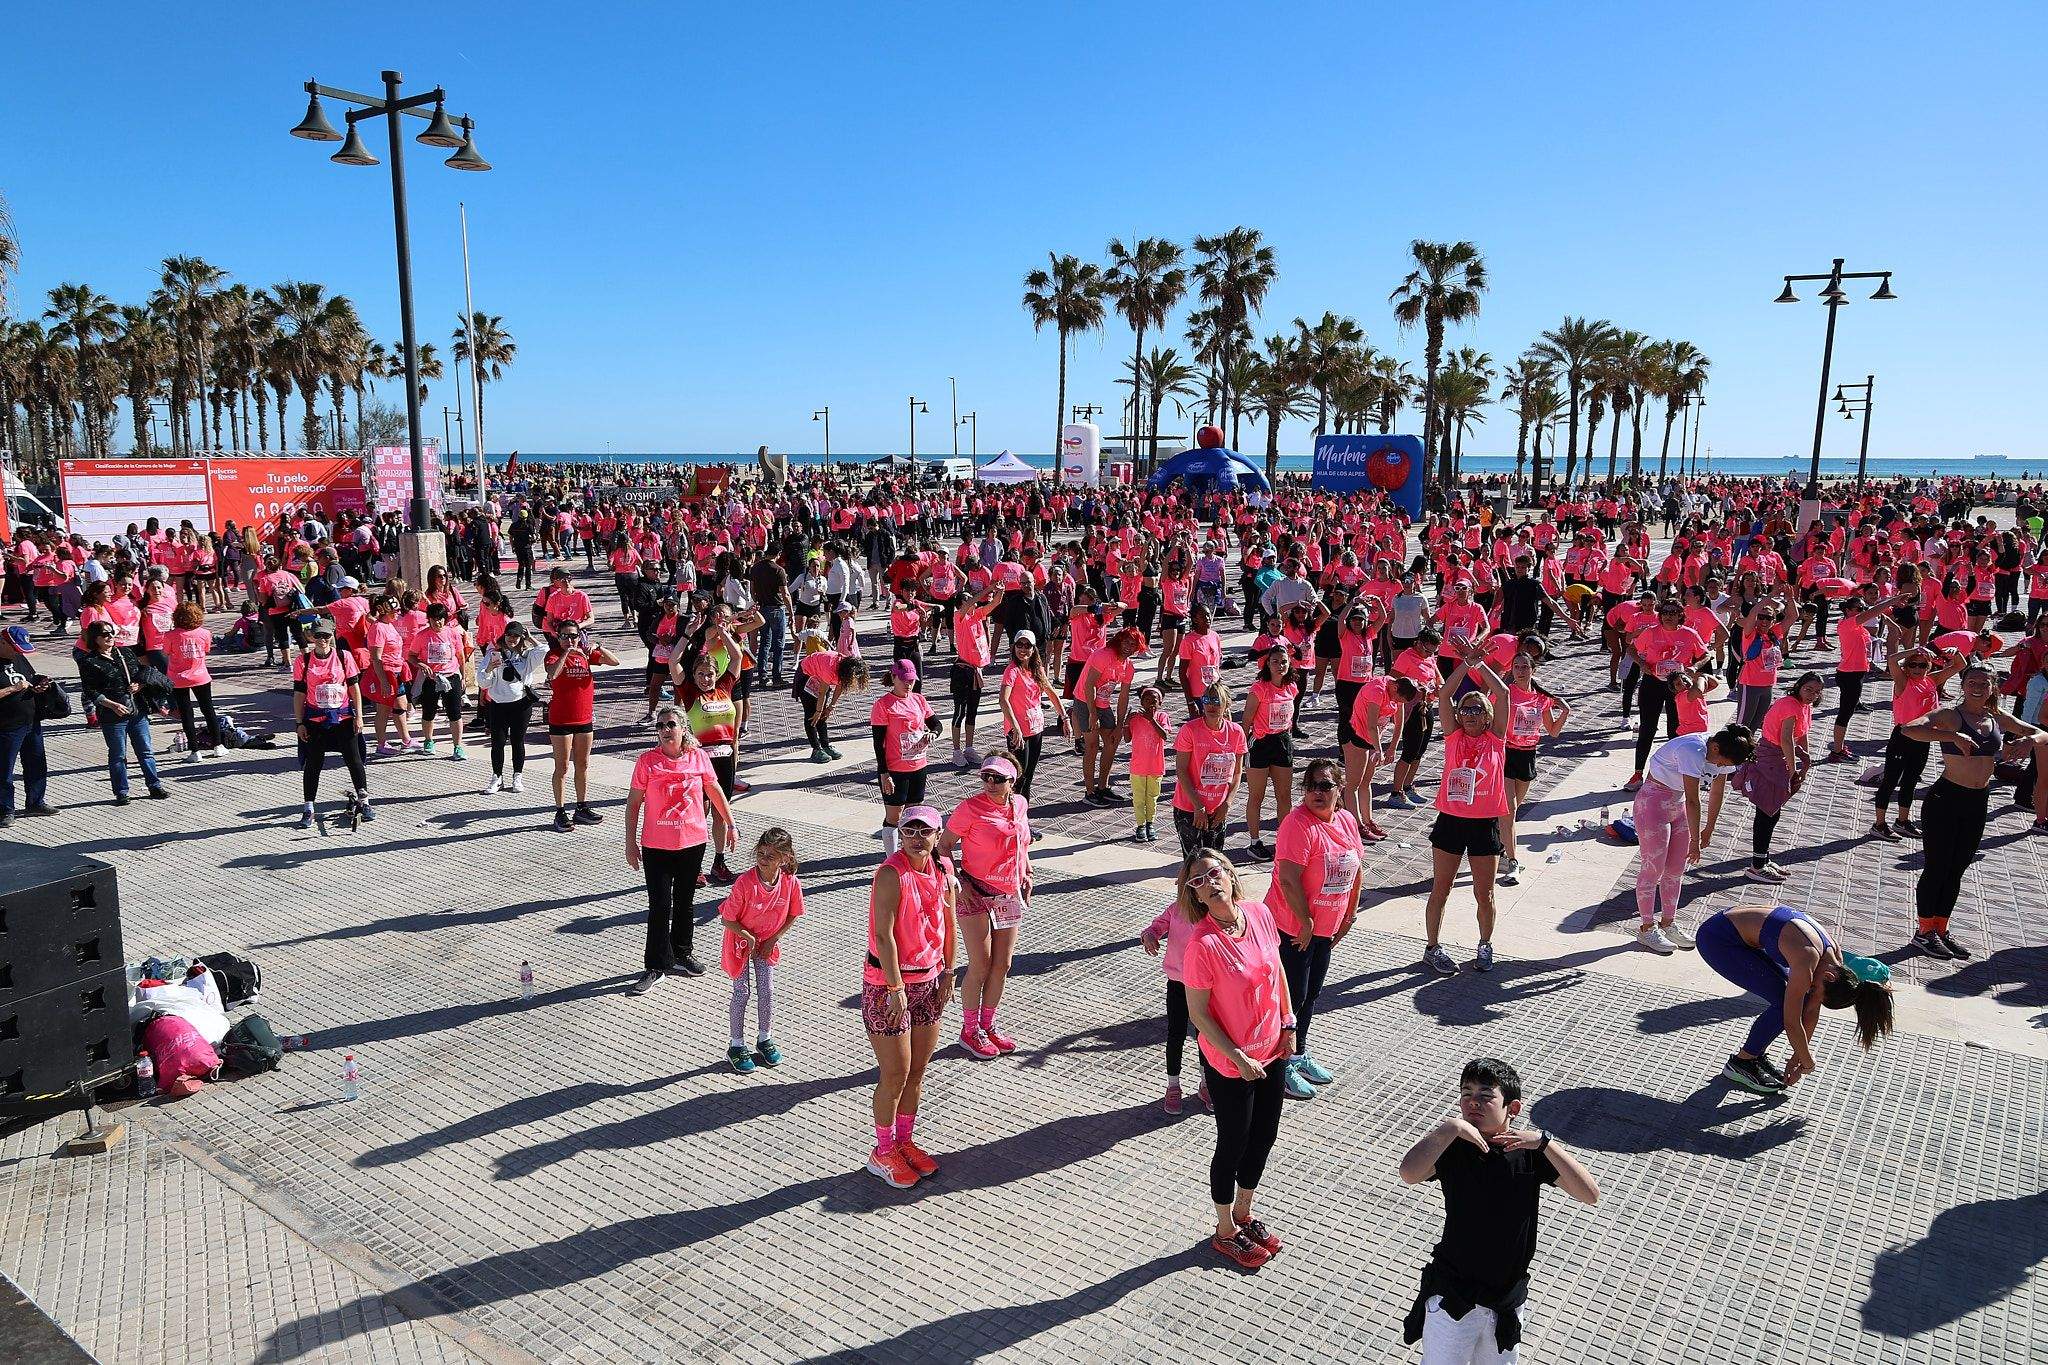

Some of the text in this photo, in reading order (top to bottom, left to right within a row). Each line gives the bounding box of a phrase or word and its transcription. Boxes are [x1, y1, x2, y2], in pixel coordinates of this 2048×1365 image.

[1317, 444, 1367, 470] Marlene
[267, 472, 308, 485] Tu pelo
[249, 484, 327, 494] vale un tesoro
[625, 491, 657, 502] OYSHO
[1337, 869, 1351, 878] 016
